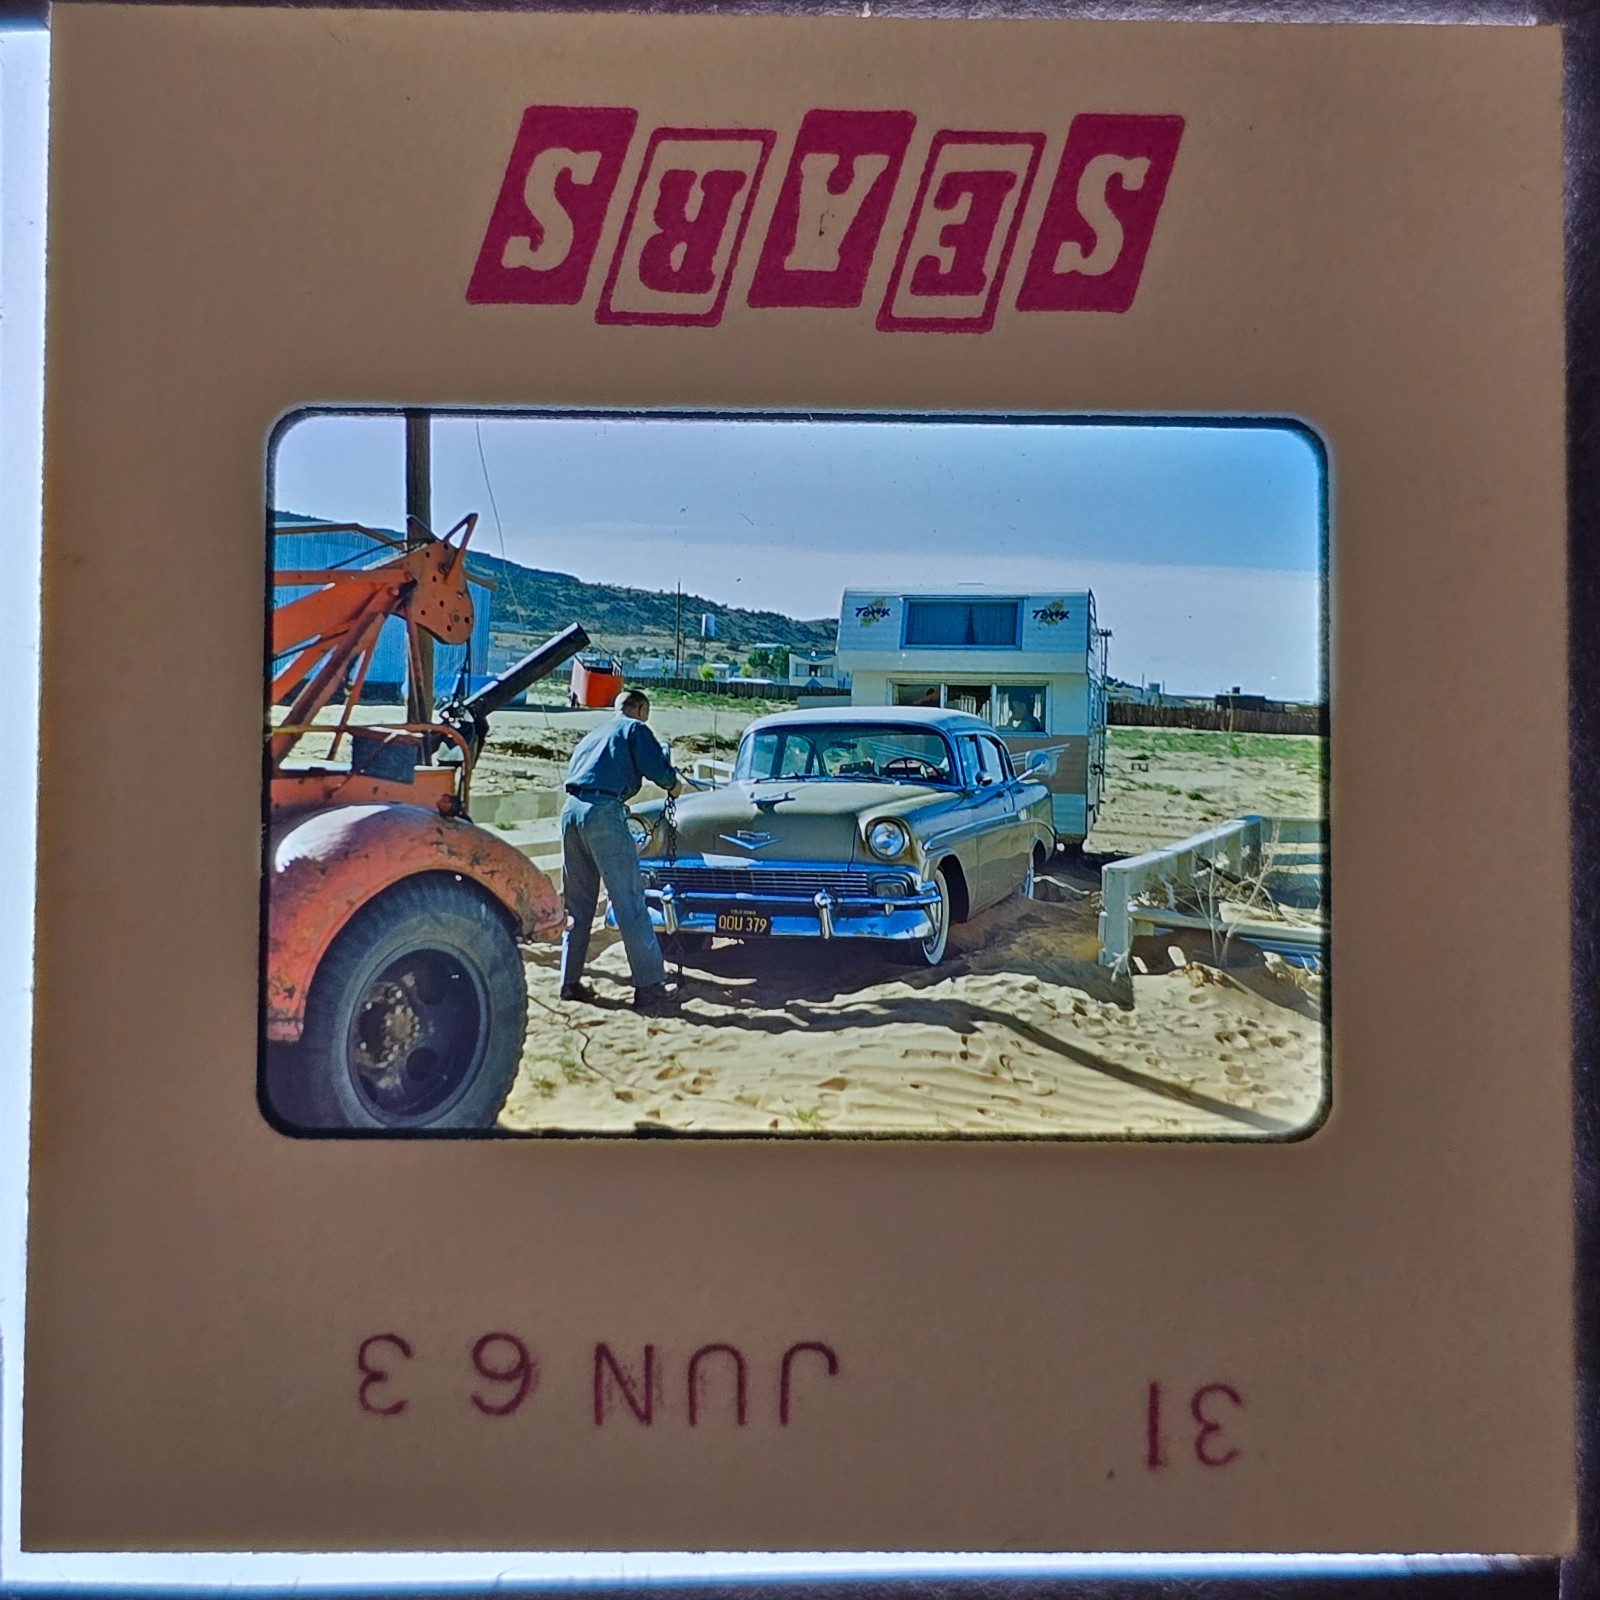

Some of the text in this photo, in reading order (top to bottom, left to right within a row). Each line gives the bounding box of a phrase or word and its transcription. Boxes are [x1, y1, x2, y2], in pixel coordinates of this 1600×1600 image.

[498, 143, 1153, 300] SEARS
[745, 916, 768, 933] 379
[593, 1340, 840, 1427] JUN
[1147, 1381, 1244, 1469] 31
